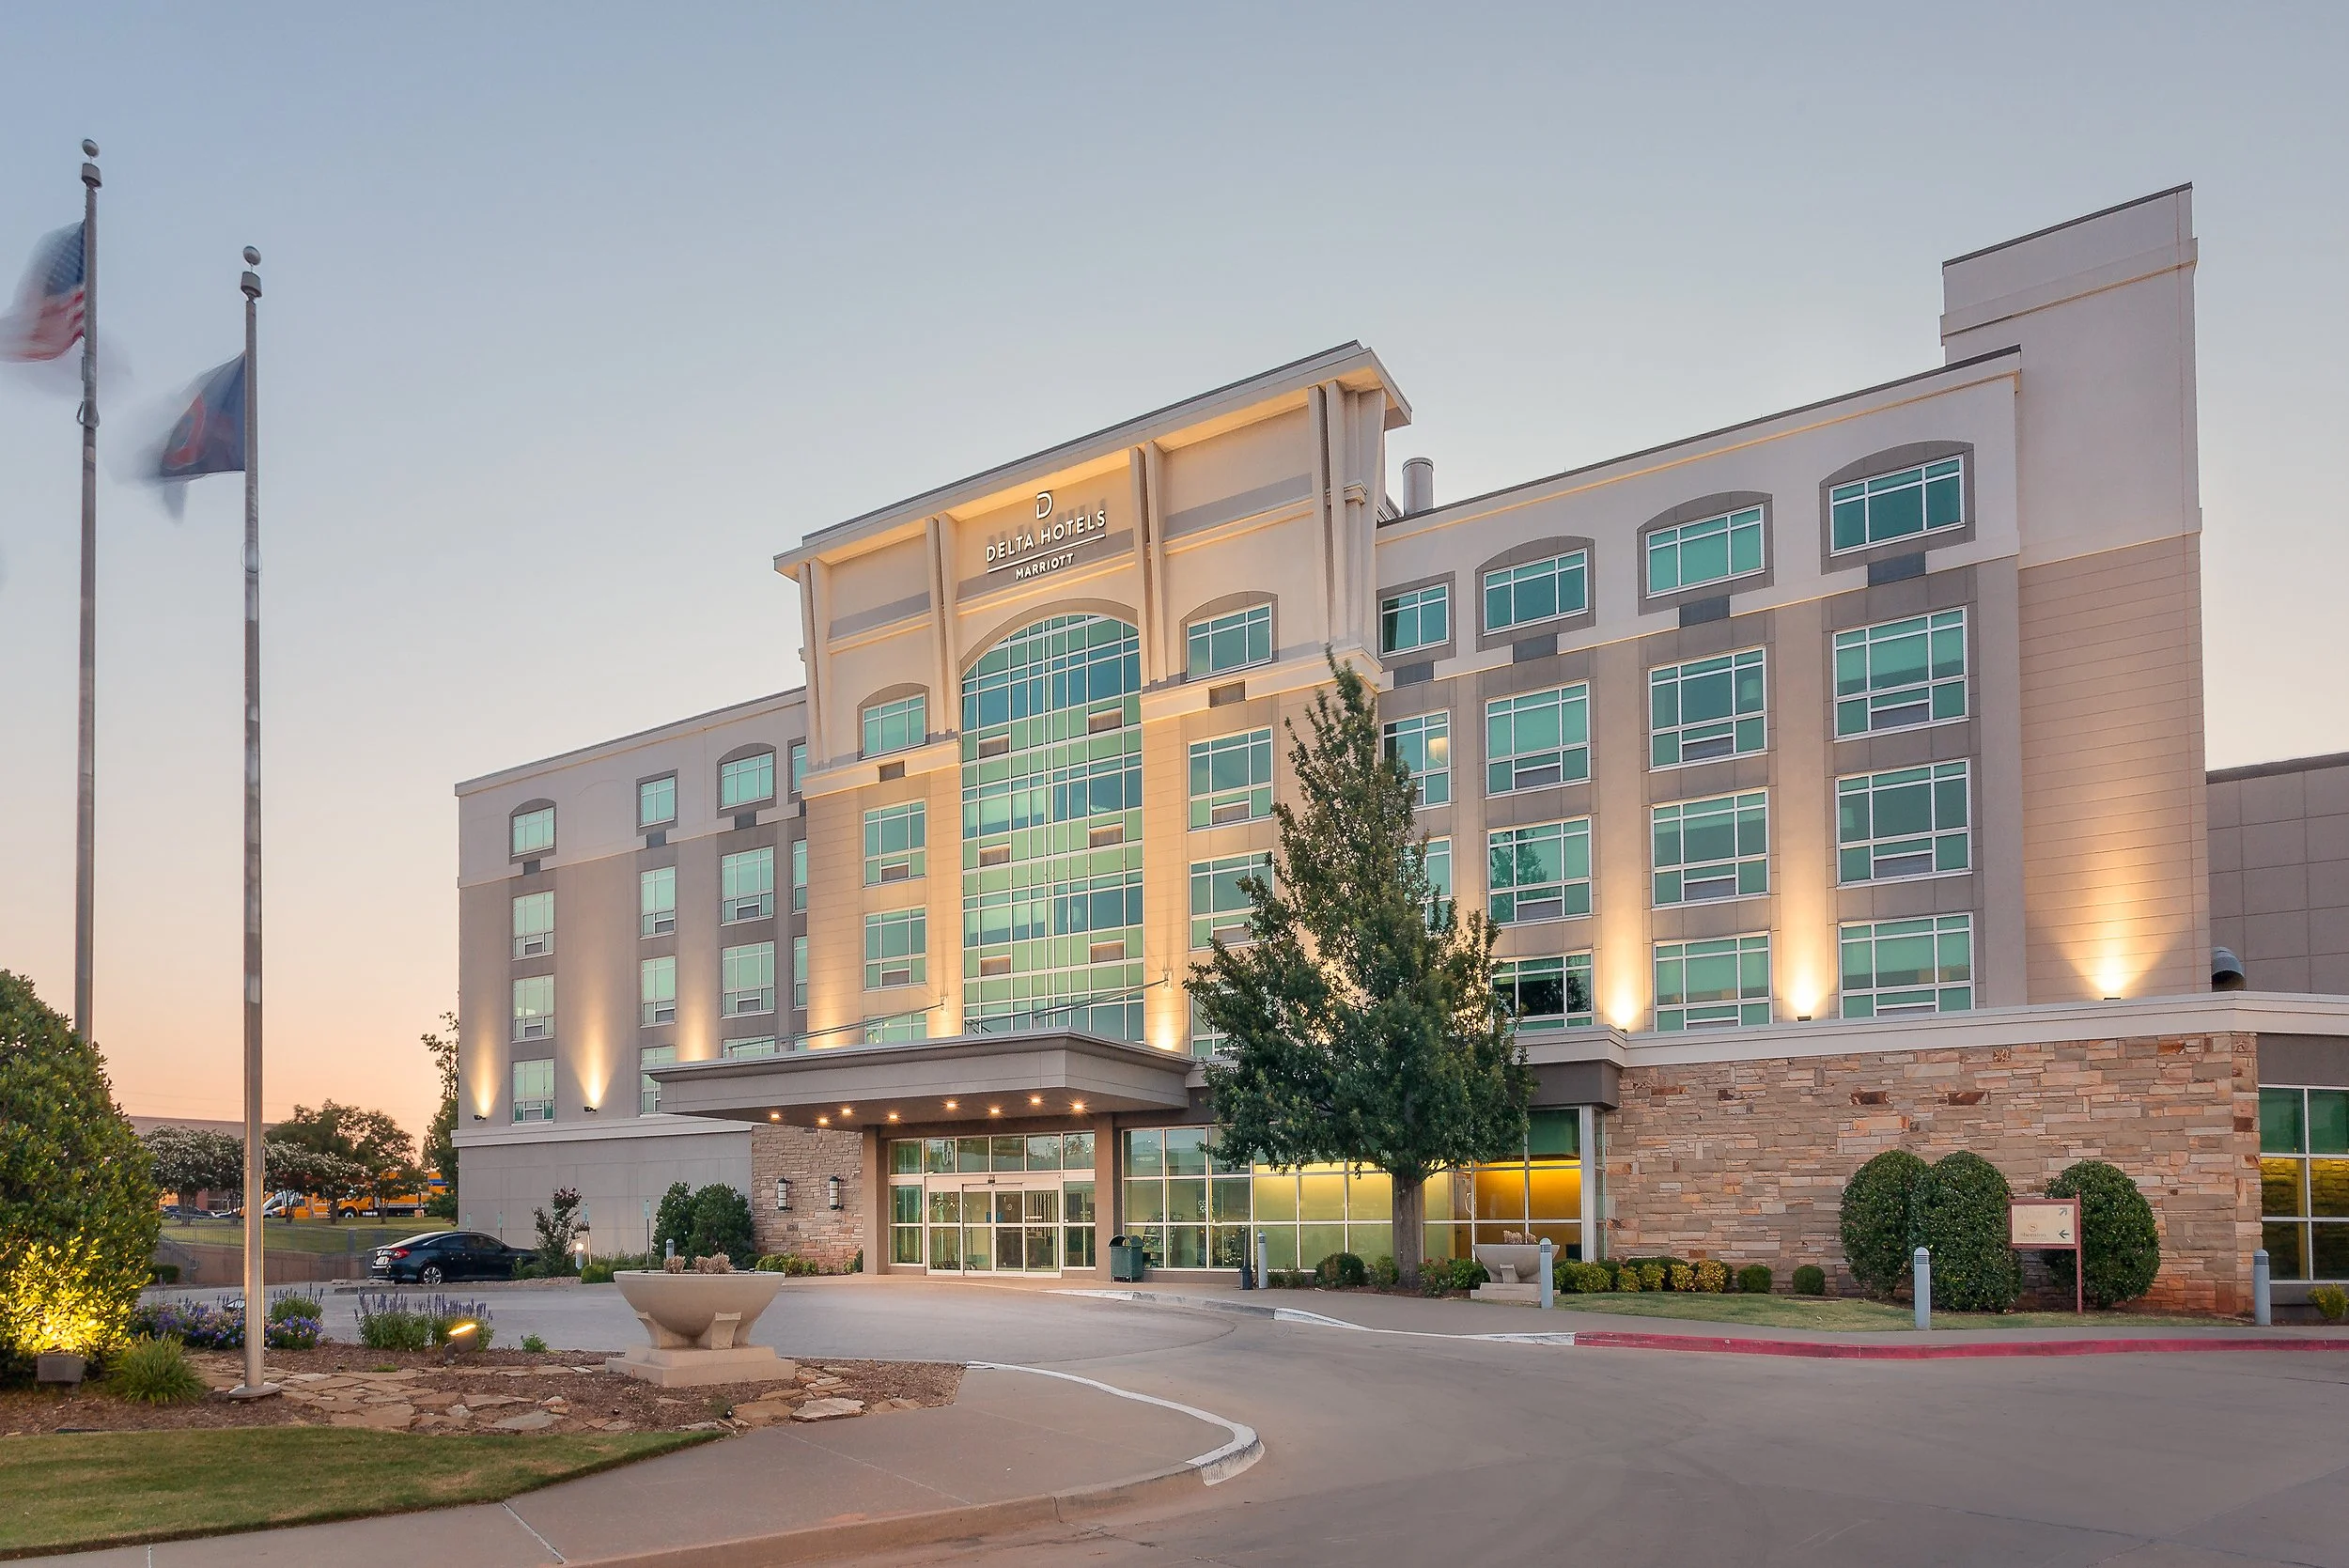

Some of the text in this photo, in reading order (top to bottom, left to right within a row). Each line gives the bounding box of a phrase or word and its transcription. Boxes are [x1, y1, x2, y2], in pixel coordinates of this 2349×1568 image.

[1035, 490, 1053, 520] D
[987, 509, 1106, 563] DELTA HOTELS
[1016, 552, 1074, 580] MARRIOTT
